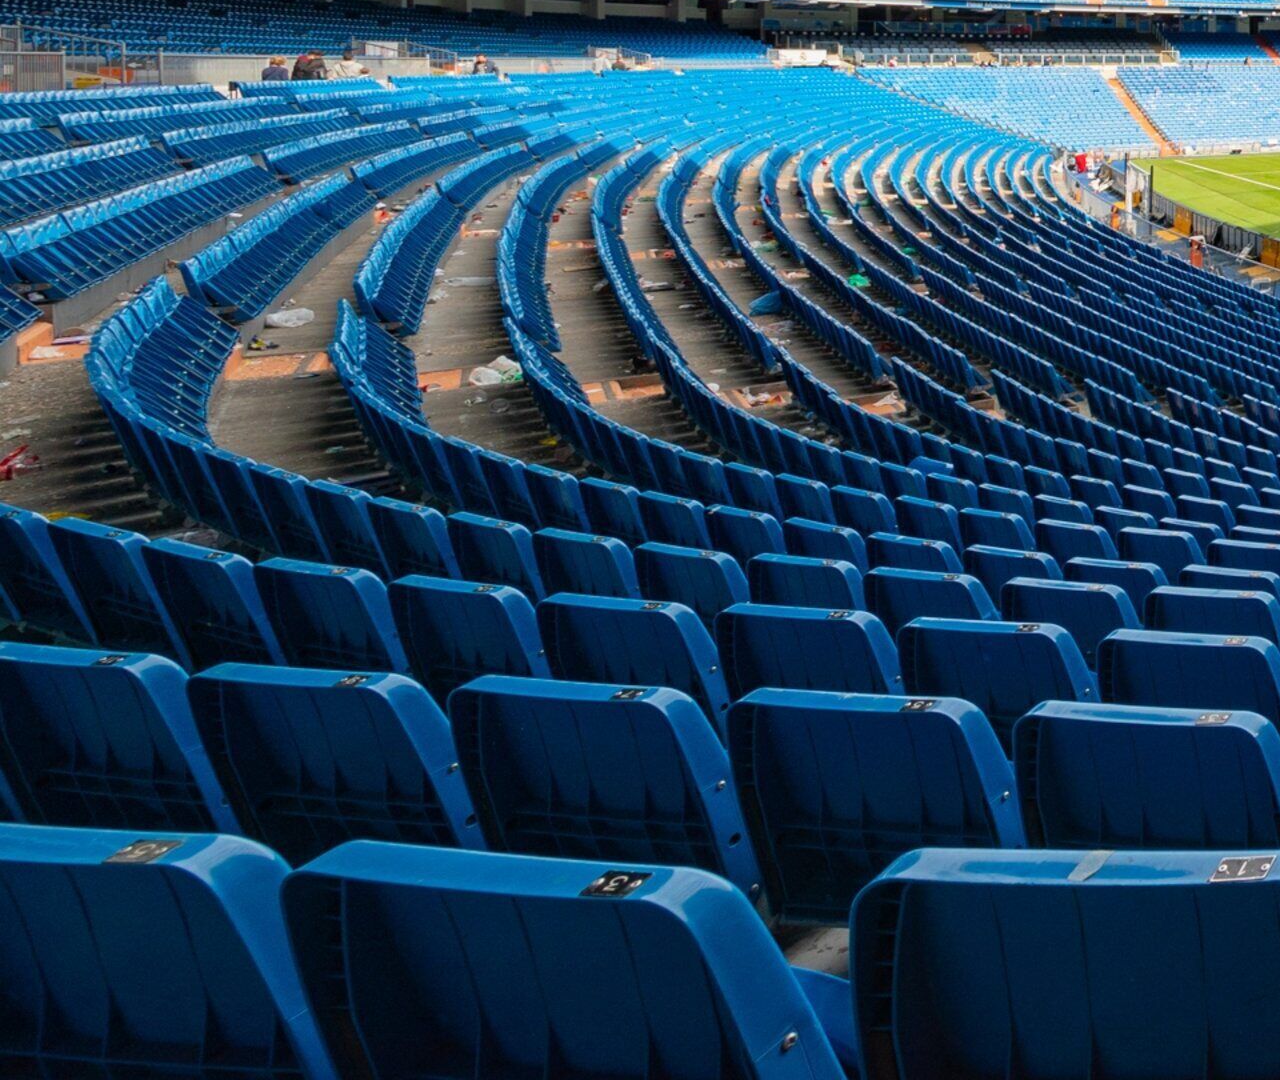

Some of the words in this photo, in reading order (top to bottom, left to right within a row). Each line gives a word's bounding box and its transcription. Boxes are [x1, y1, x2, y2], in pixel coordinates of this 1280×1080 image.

[127, 843, 157, 858] 5
[1236, 860, 1247, 876] 1
[602, 875, 629, 892] 3
